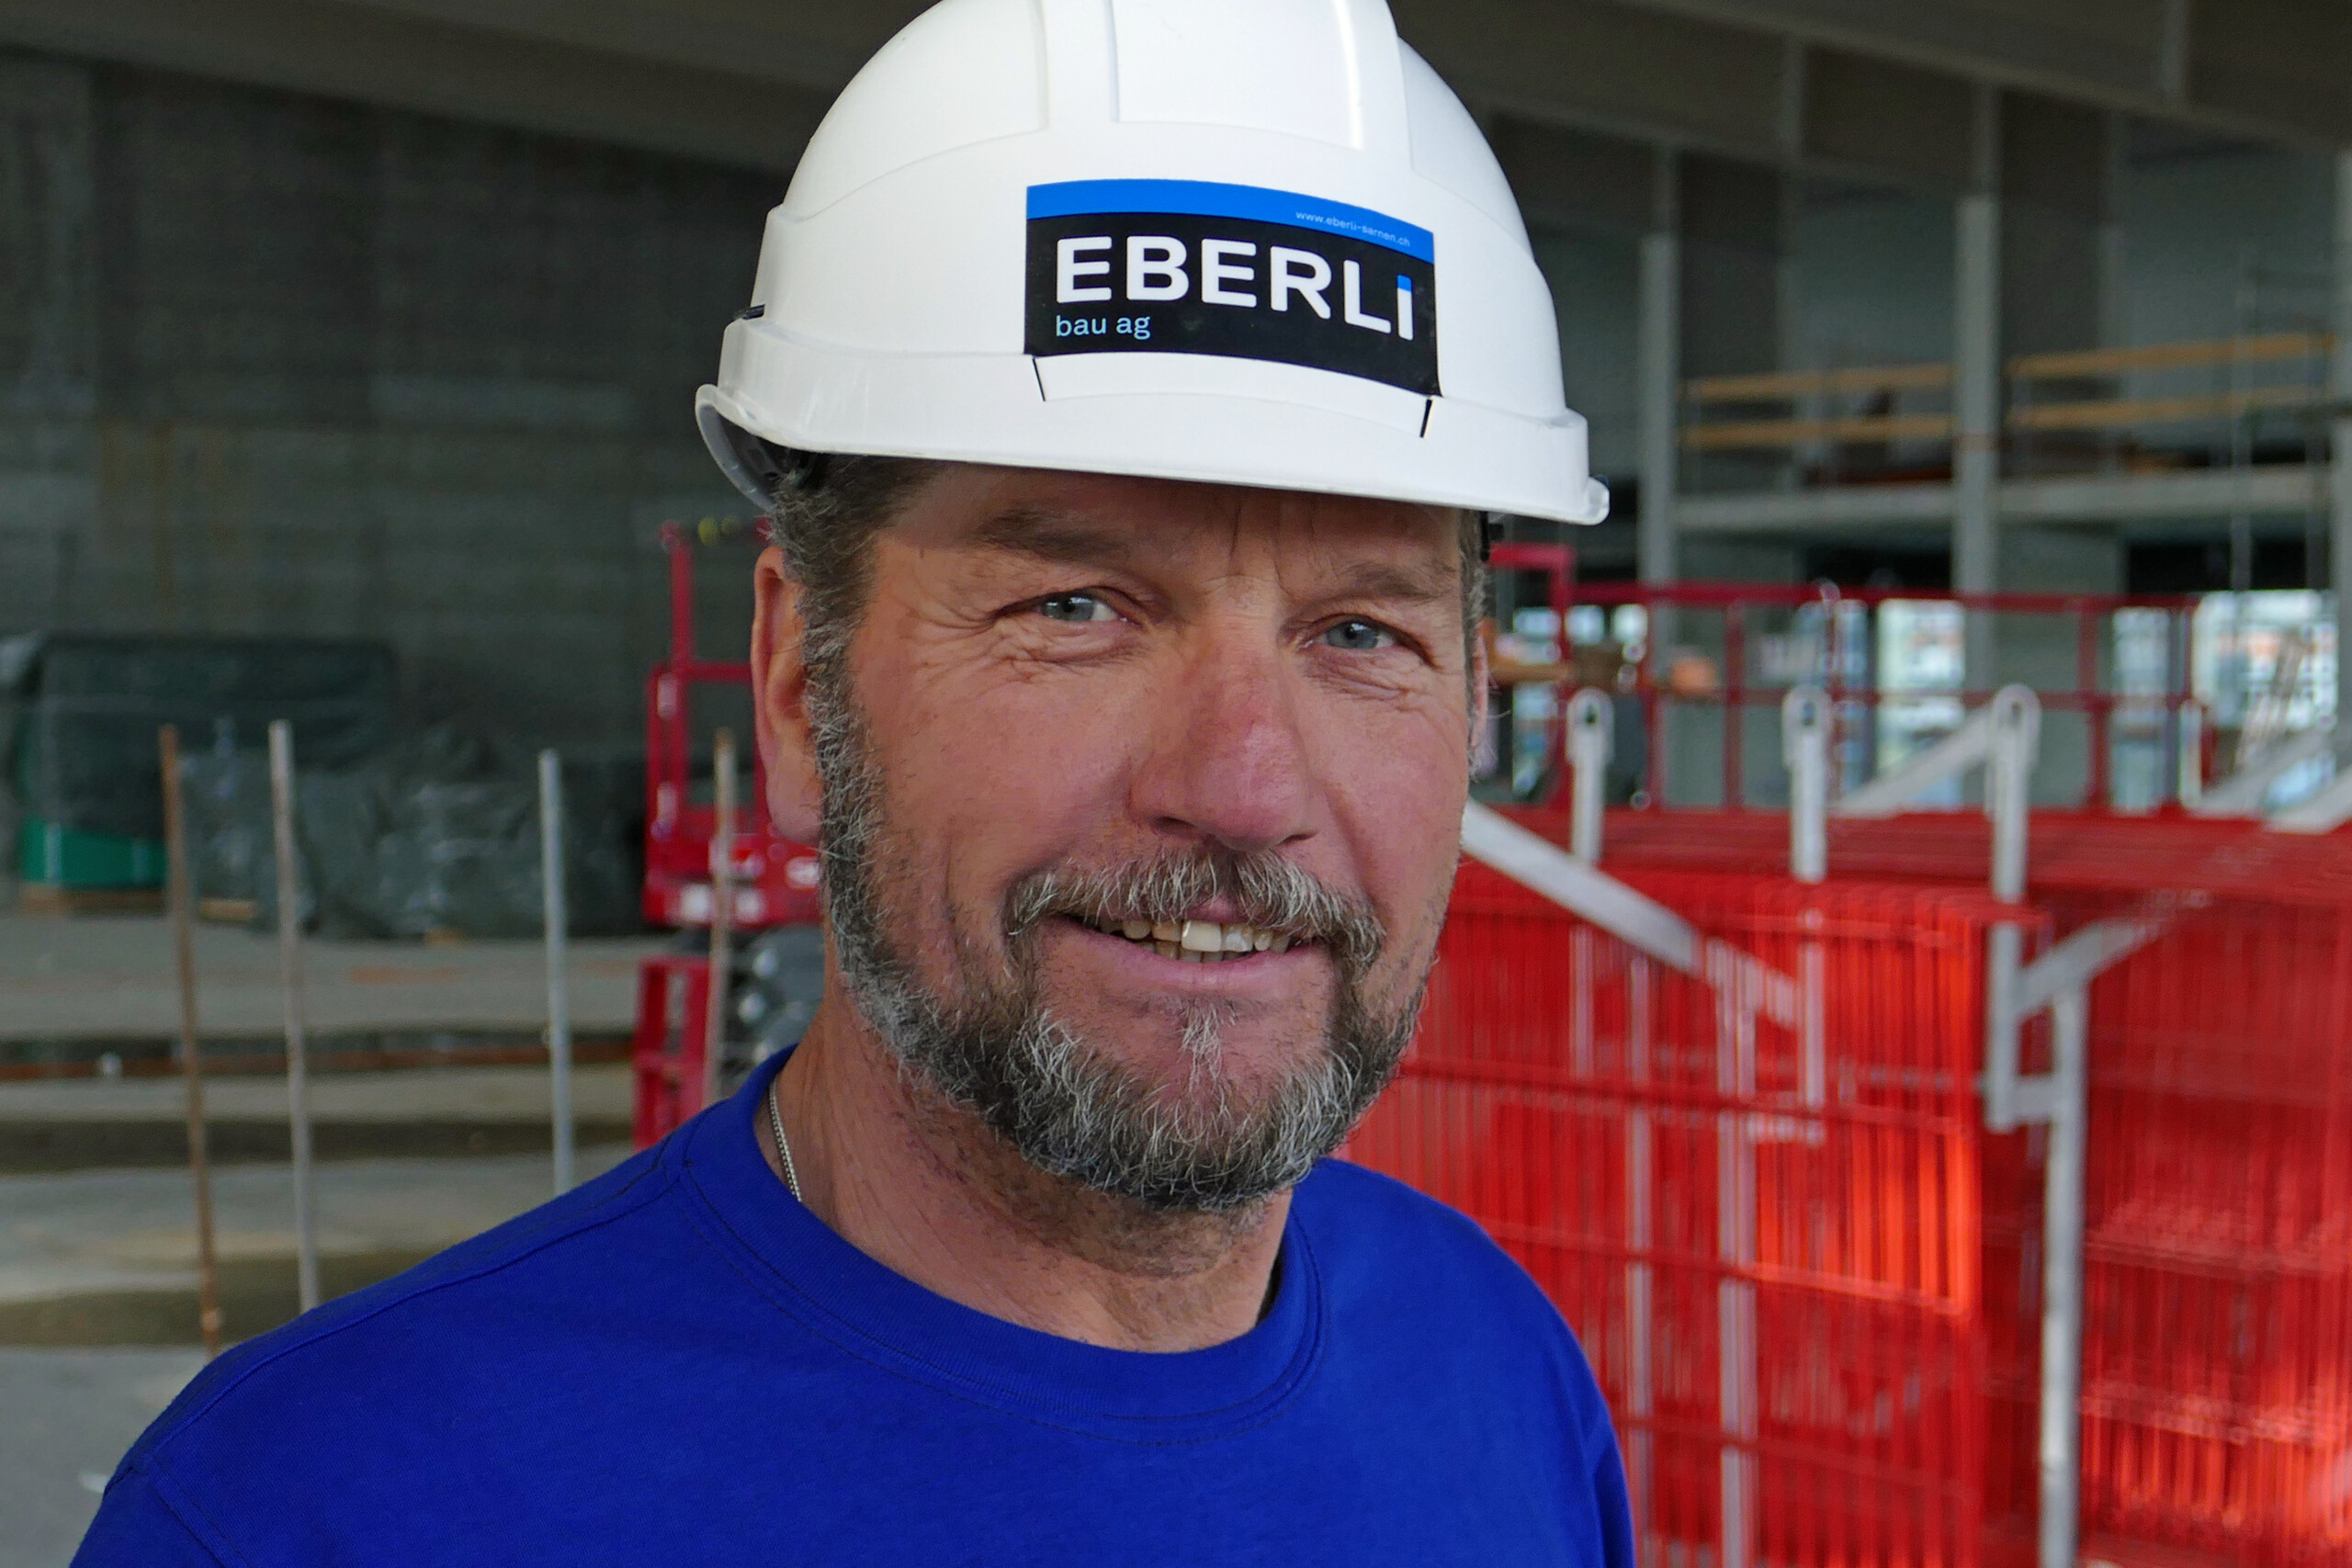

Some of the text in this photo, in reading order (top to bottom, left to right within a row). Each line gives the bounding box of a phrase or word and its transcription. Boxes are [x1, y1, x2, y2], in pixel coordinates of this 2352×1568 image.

[1295, 211, 1410, 246] www.eberli-sarnen.ch
[1056, 315, 1150, 340] bau ag
